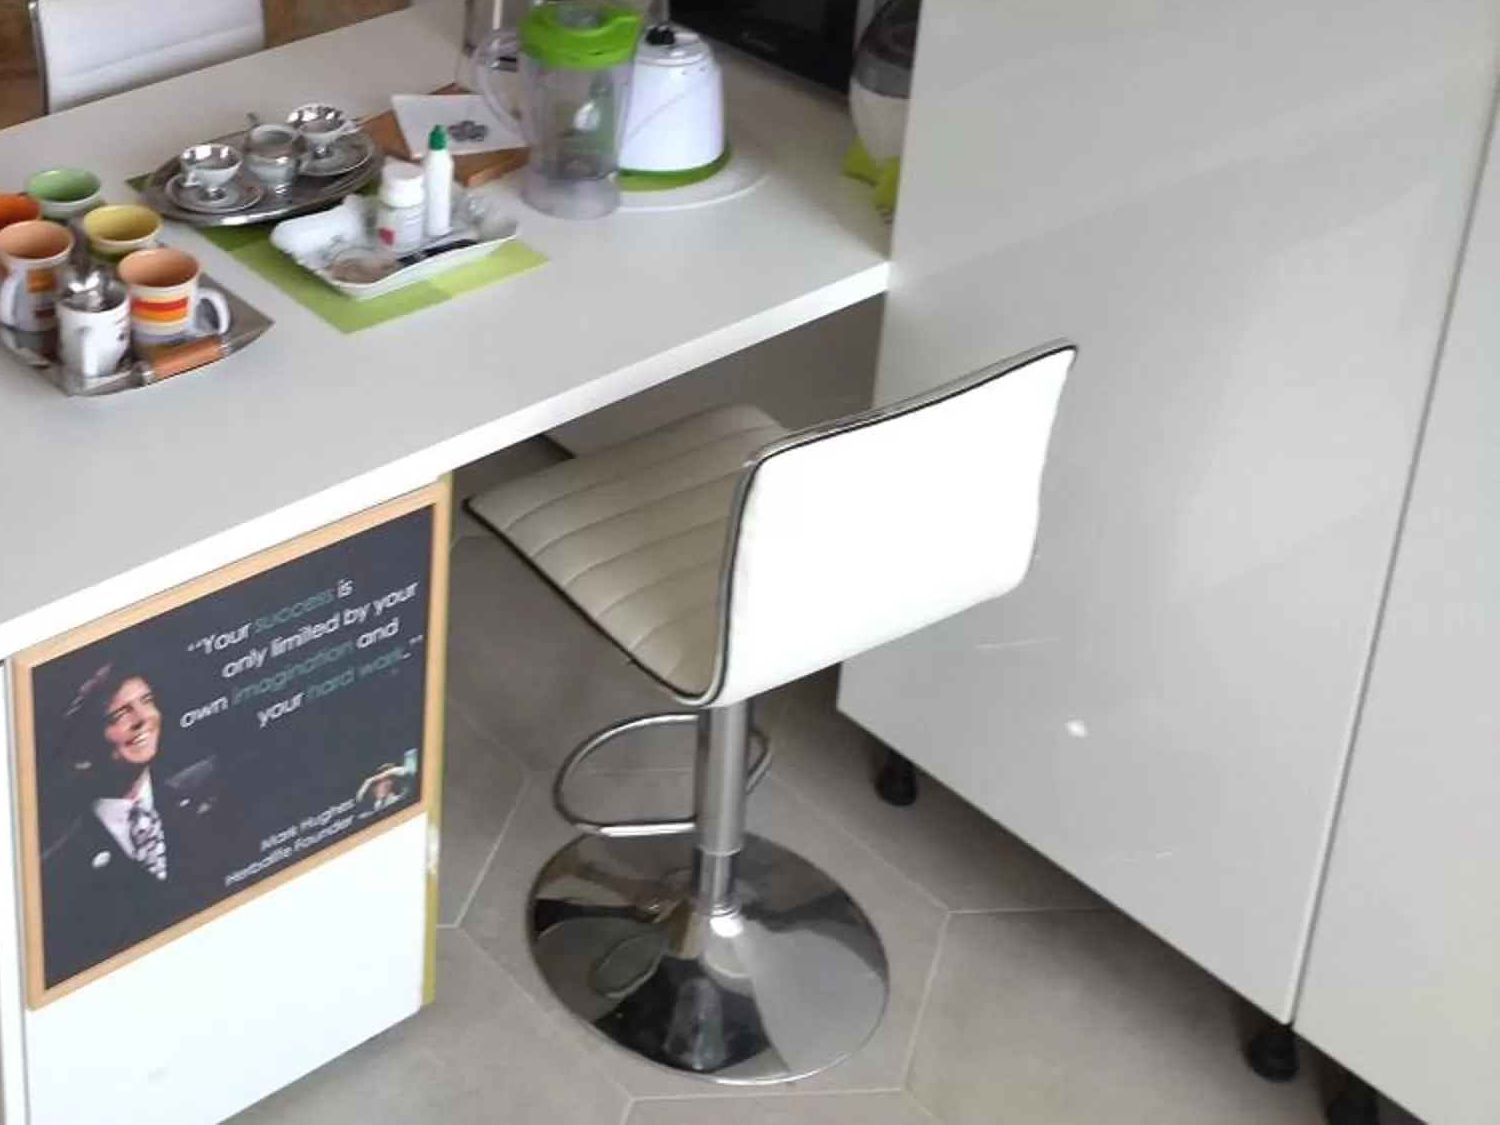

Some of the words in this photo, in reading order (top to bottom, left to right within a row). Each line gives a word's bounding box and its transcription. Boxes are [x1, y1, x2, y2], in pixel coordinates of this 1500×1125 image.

[222, 647, 268, 678] only
[271, 612, 340, 658] limited
[343, 602, 371, 626] by
[373, 581, 420, 616] your
[253, 588, 336, 633] success
[337, 579, 353, 598] is
[179, 696, 229, 728] own
[231, 640, 354, 706] imagination
[356, 617, 399, 649] and
[257, 692, 304, 728] your
[306, 667, 355, 700] hard
